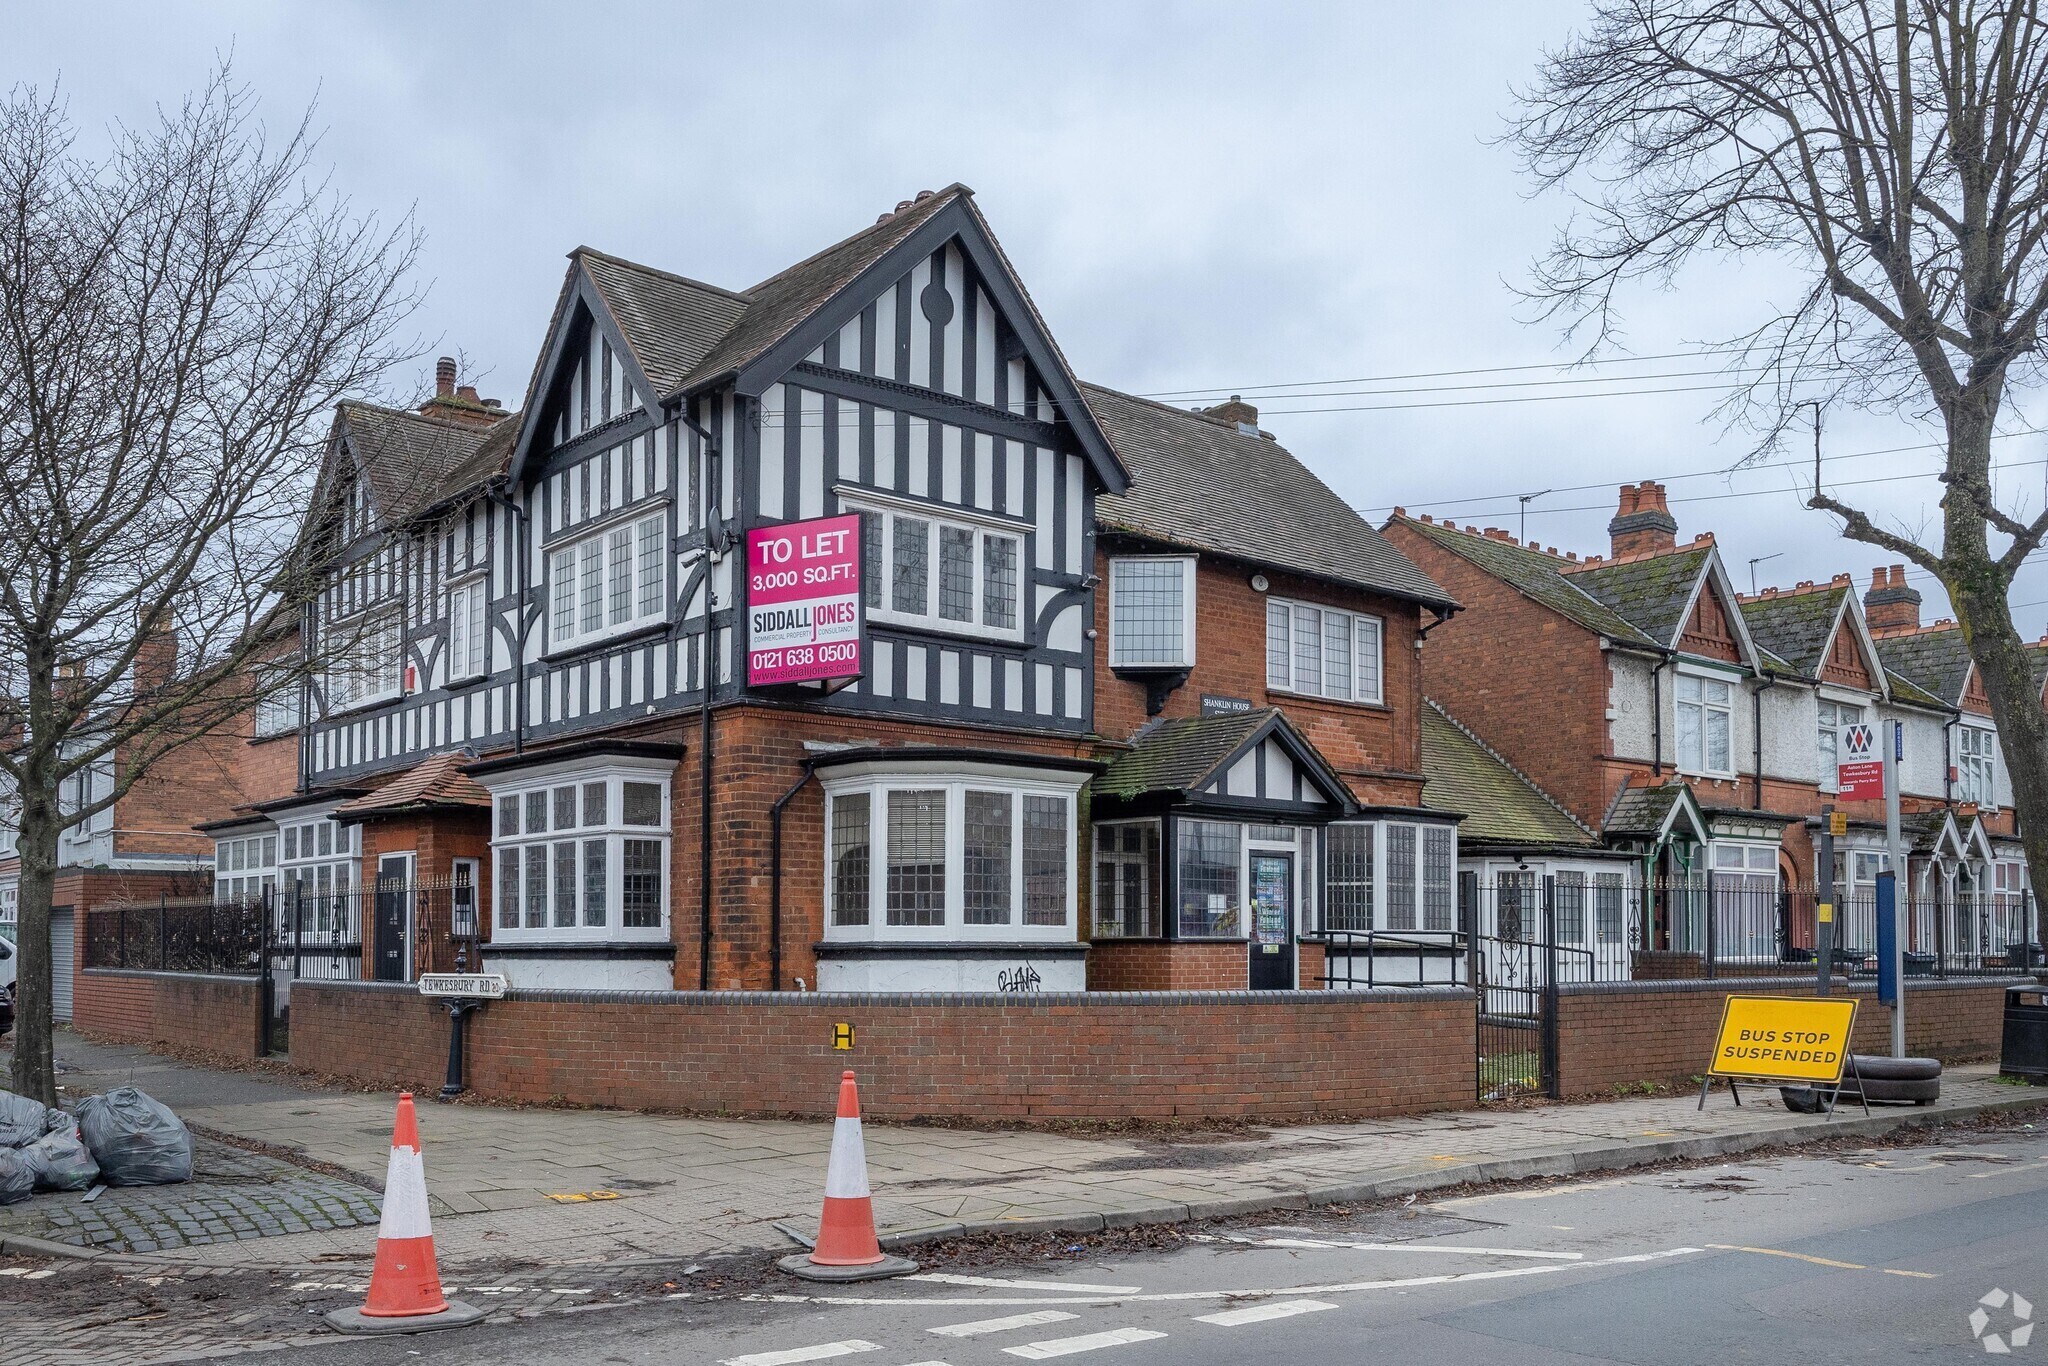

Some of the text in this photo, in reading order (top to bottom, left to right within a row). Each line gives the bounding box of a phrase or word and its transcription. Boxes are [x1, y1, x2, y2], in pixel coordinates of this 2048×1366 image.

[757, 529, 850, 565] TO LET
[752, 562, 856, 592] 3,000 SQ.FT.
[753, 625, 854, 643] COMMERCIAL PROPERTY CONSULTANCY
[752, 643, 856, 670] 0121 638 0500
[753, 662, 856, 681] www.siddalljones.com
[1203, 698, 1250, 711] SHANKLIN HOUSE
[423, 978, 475, 992] TEWKESBURY
[479, 980, 490, 993] RD
[834, 1025, 852, 1048] H
[1740, 1029, 1830, 1045] BUS STOP
[1723, 1046, 1837, 1064] SUSPENDED
